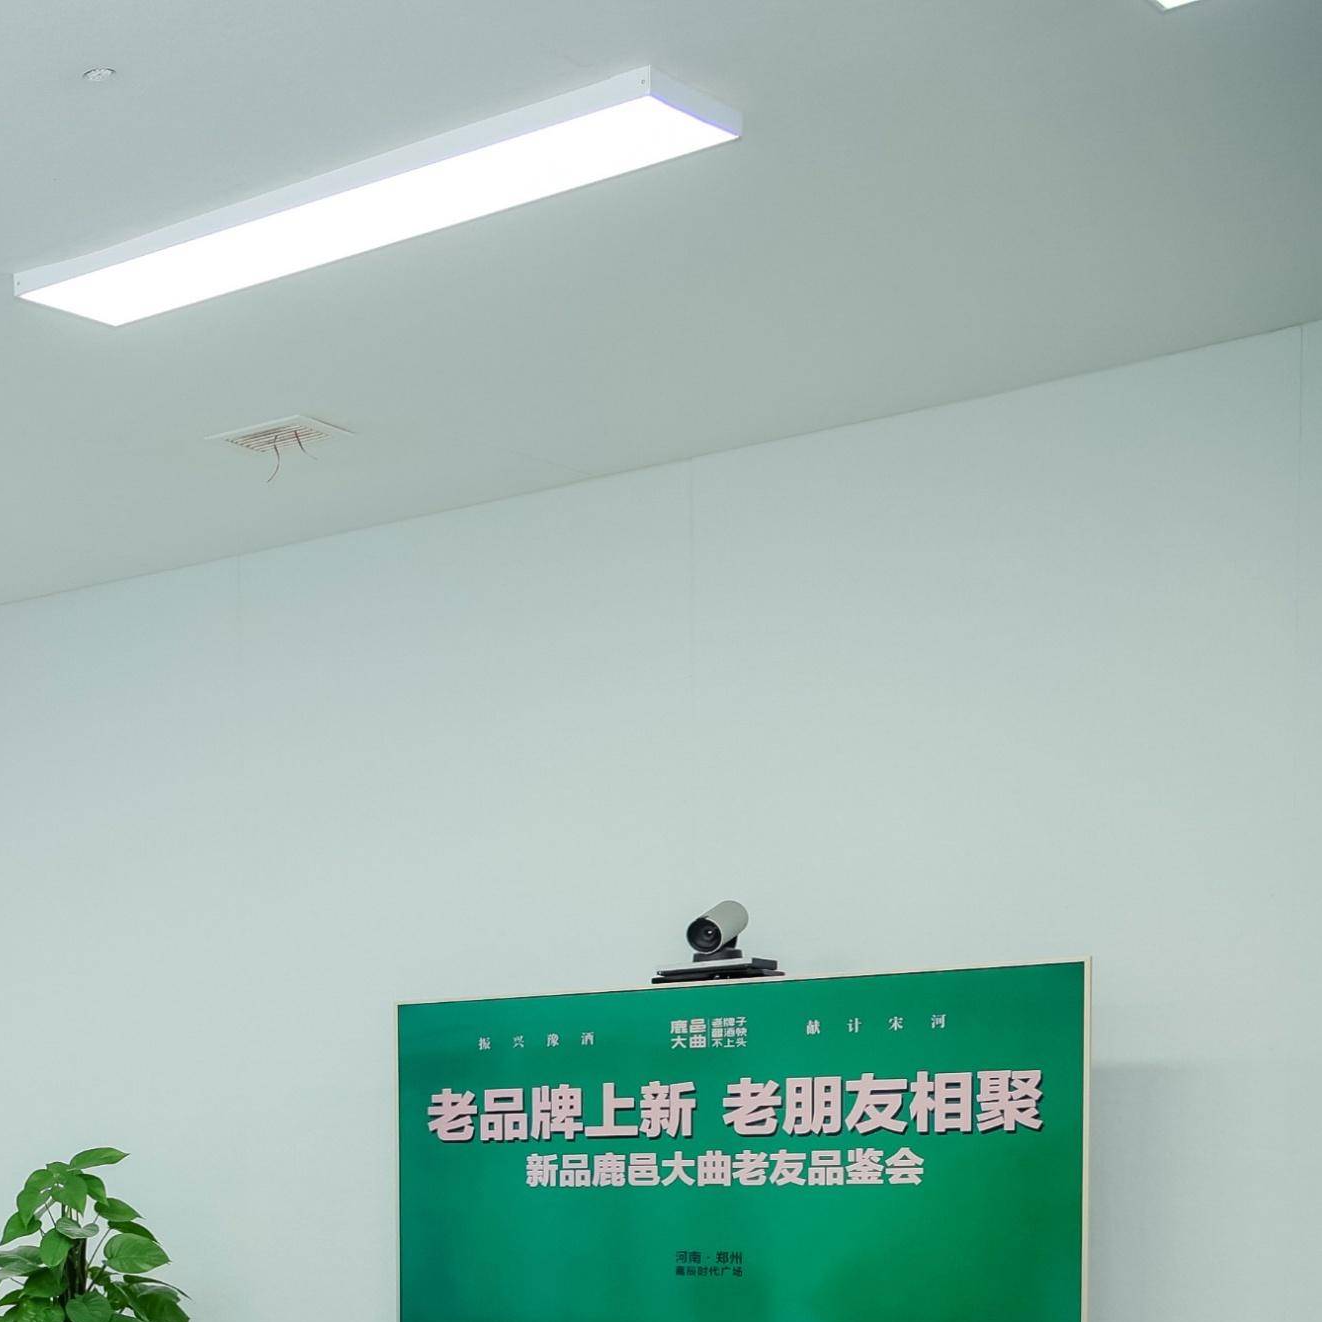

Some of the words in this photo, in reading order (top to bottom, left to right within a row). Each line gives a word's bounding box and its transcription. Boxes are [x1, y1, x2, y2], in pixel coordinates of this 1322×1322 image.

[670, 1018, 706, 1034] 鹿邑
[806, 1014, 946, 1035] 献计宋河
[671, 1034, 706, 1049] 大曲
[711, 1037, 747, 1048] 不上头
[427, 1080, 698, 1142] 老品牌上新
[722, 1069, 1044, 1136] 老朋友相聚
[525, 1147, 926, 1188] 新品鹿邑大曲老友品鉴会
